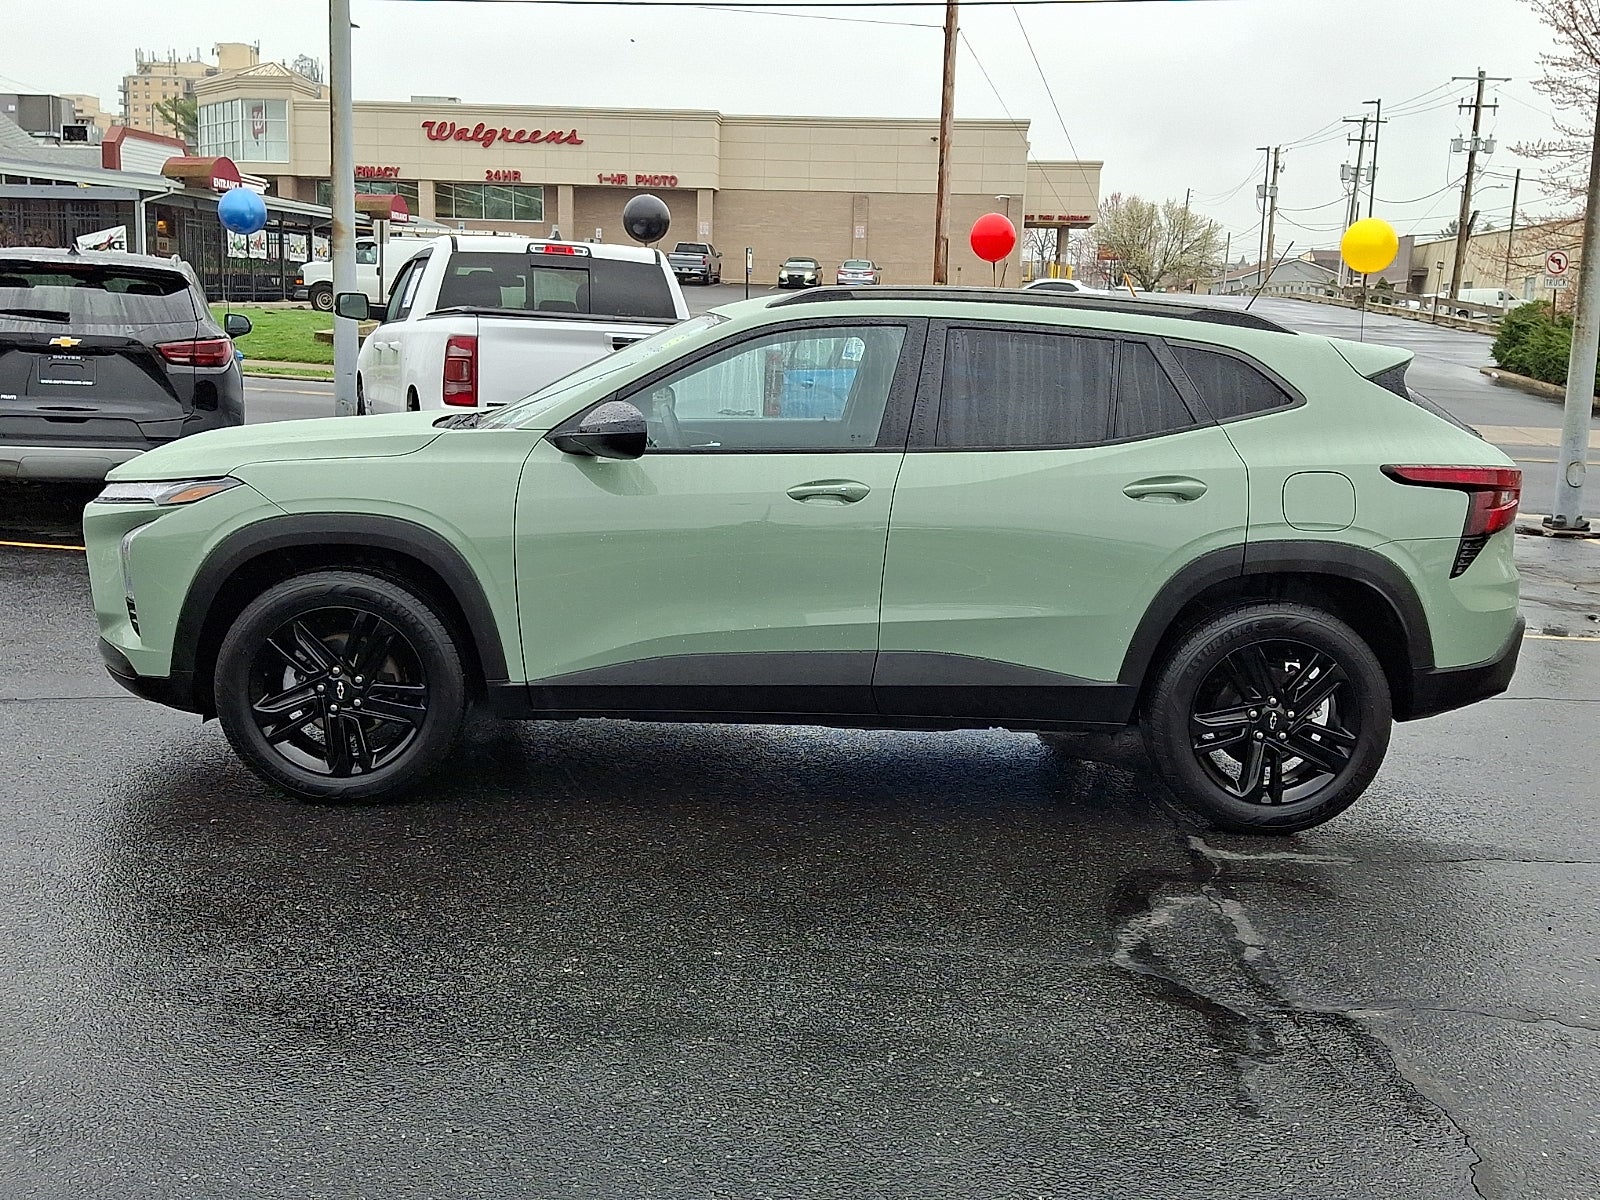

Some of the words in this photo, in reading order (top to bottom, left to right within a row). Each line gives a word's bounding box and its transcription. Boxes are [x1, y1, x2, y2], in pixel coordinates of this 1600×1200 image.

[421, 120, 584, 148] Walgreens
[354, 164, 401, 178] RMACY
[485, 169, 522, 182] 24HR
[596, 173, 628, 186] 1-HR
[634, 174, 678, 187] PHOTO
[1545, 279, 1567, 287] TRUCK
